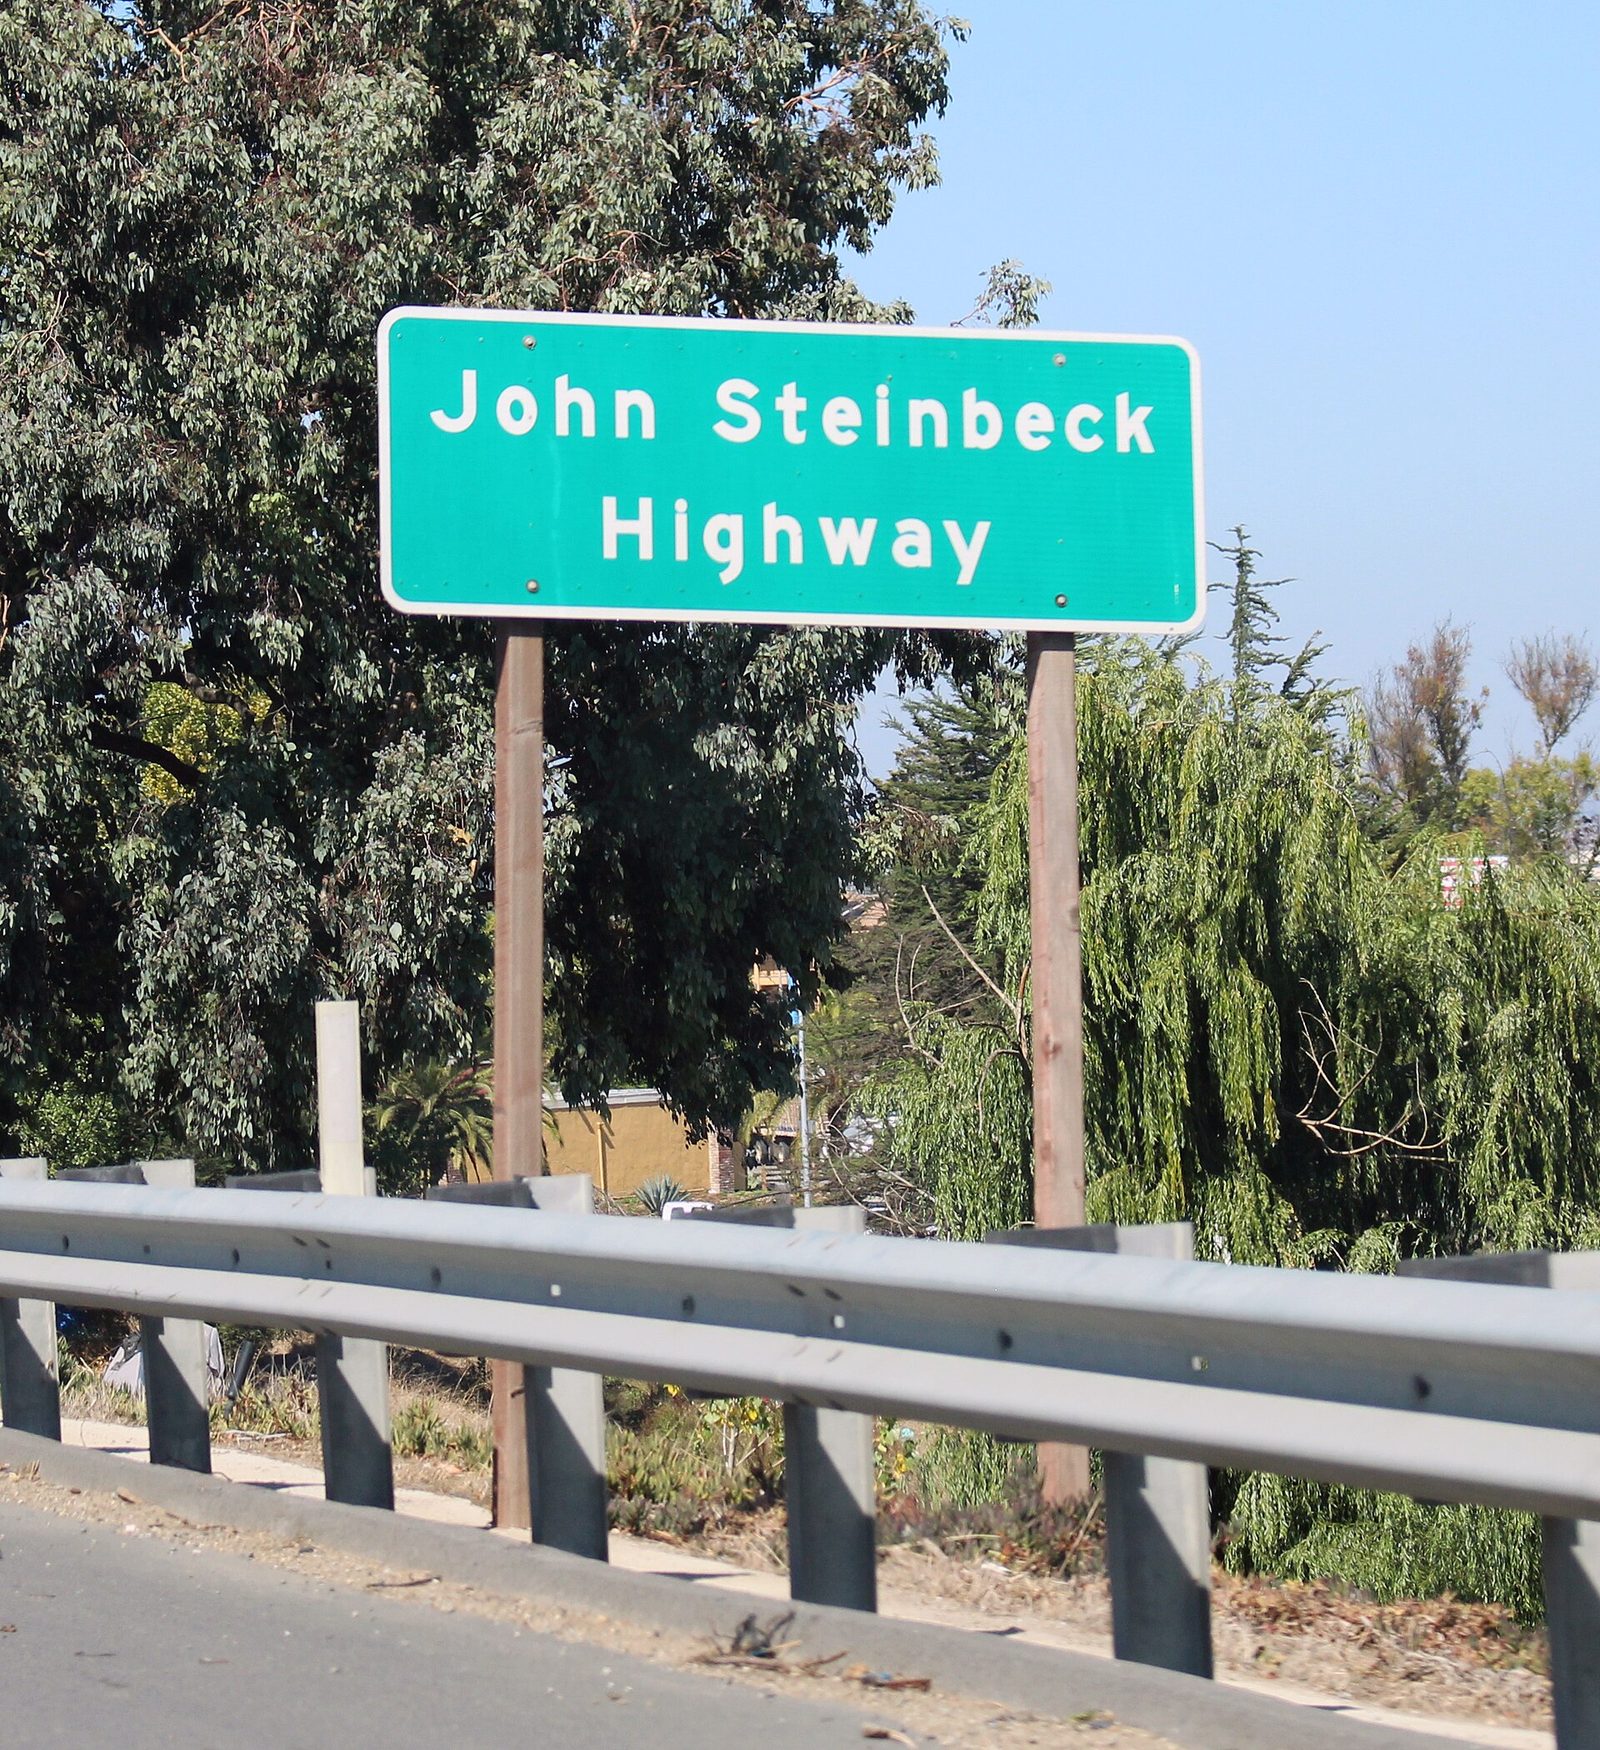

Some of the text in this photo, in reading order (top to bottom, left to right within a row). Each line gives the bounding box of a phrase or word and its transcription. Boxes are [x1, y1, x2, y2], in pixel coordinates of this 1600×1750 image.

[430, 369, 1155, 454] John Steinbeck
[602, 496, 991, 585] Highway
